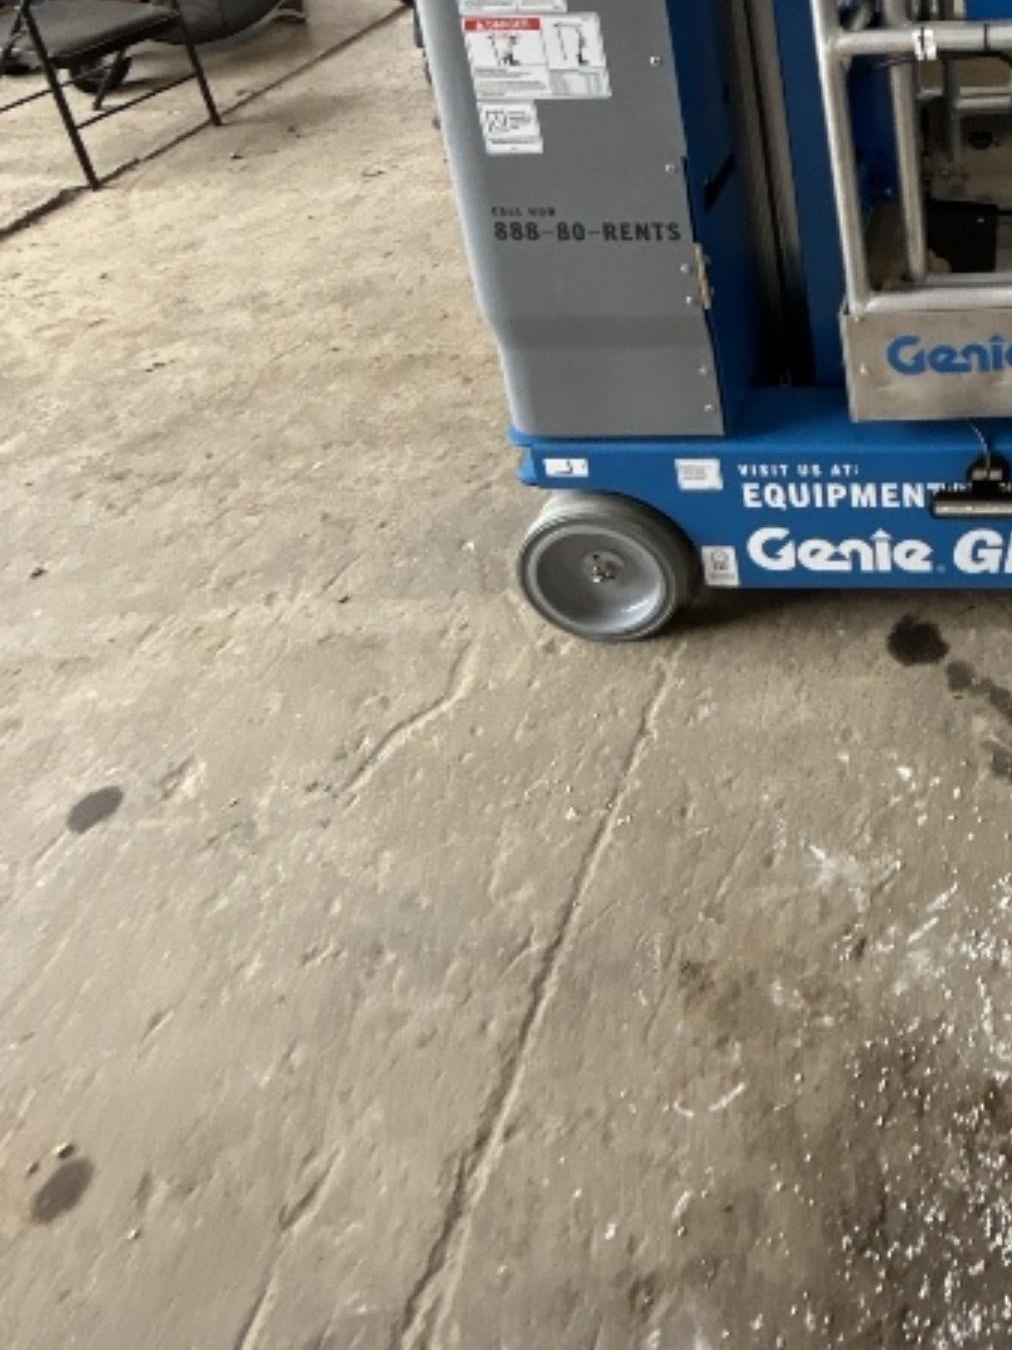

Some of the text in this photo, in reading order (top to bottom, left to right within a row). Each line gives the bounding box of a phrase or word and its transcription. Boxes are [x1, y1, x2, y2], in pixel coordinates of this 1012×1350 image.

[494, 221, 682, 242] 888-80-RENTS
[737, 464, 860, 477] VISIT US AT:
[746, 526, 935, 571] Genie
